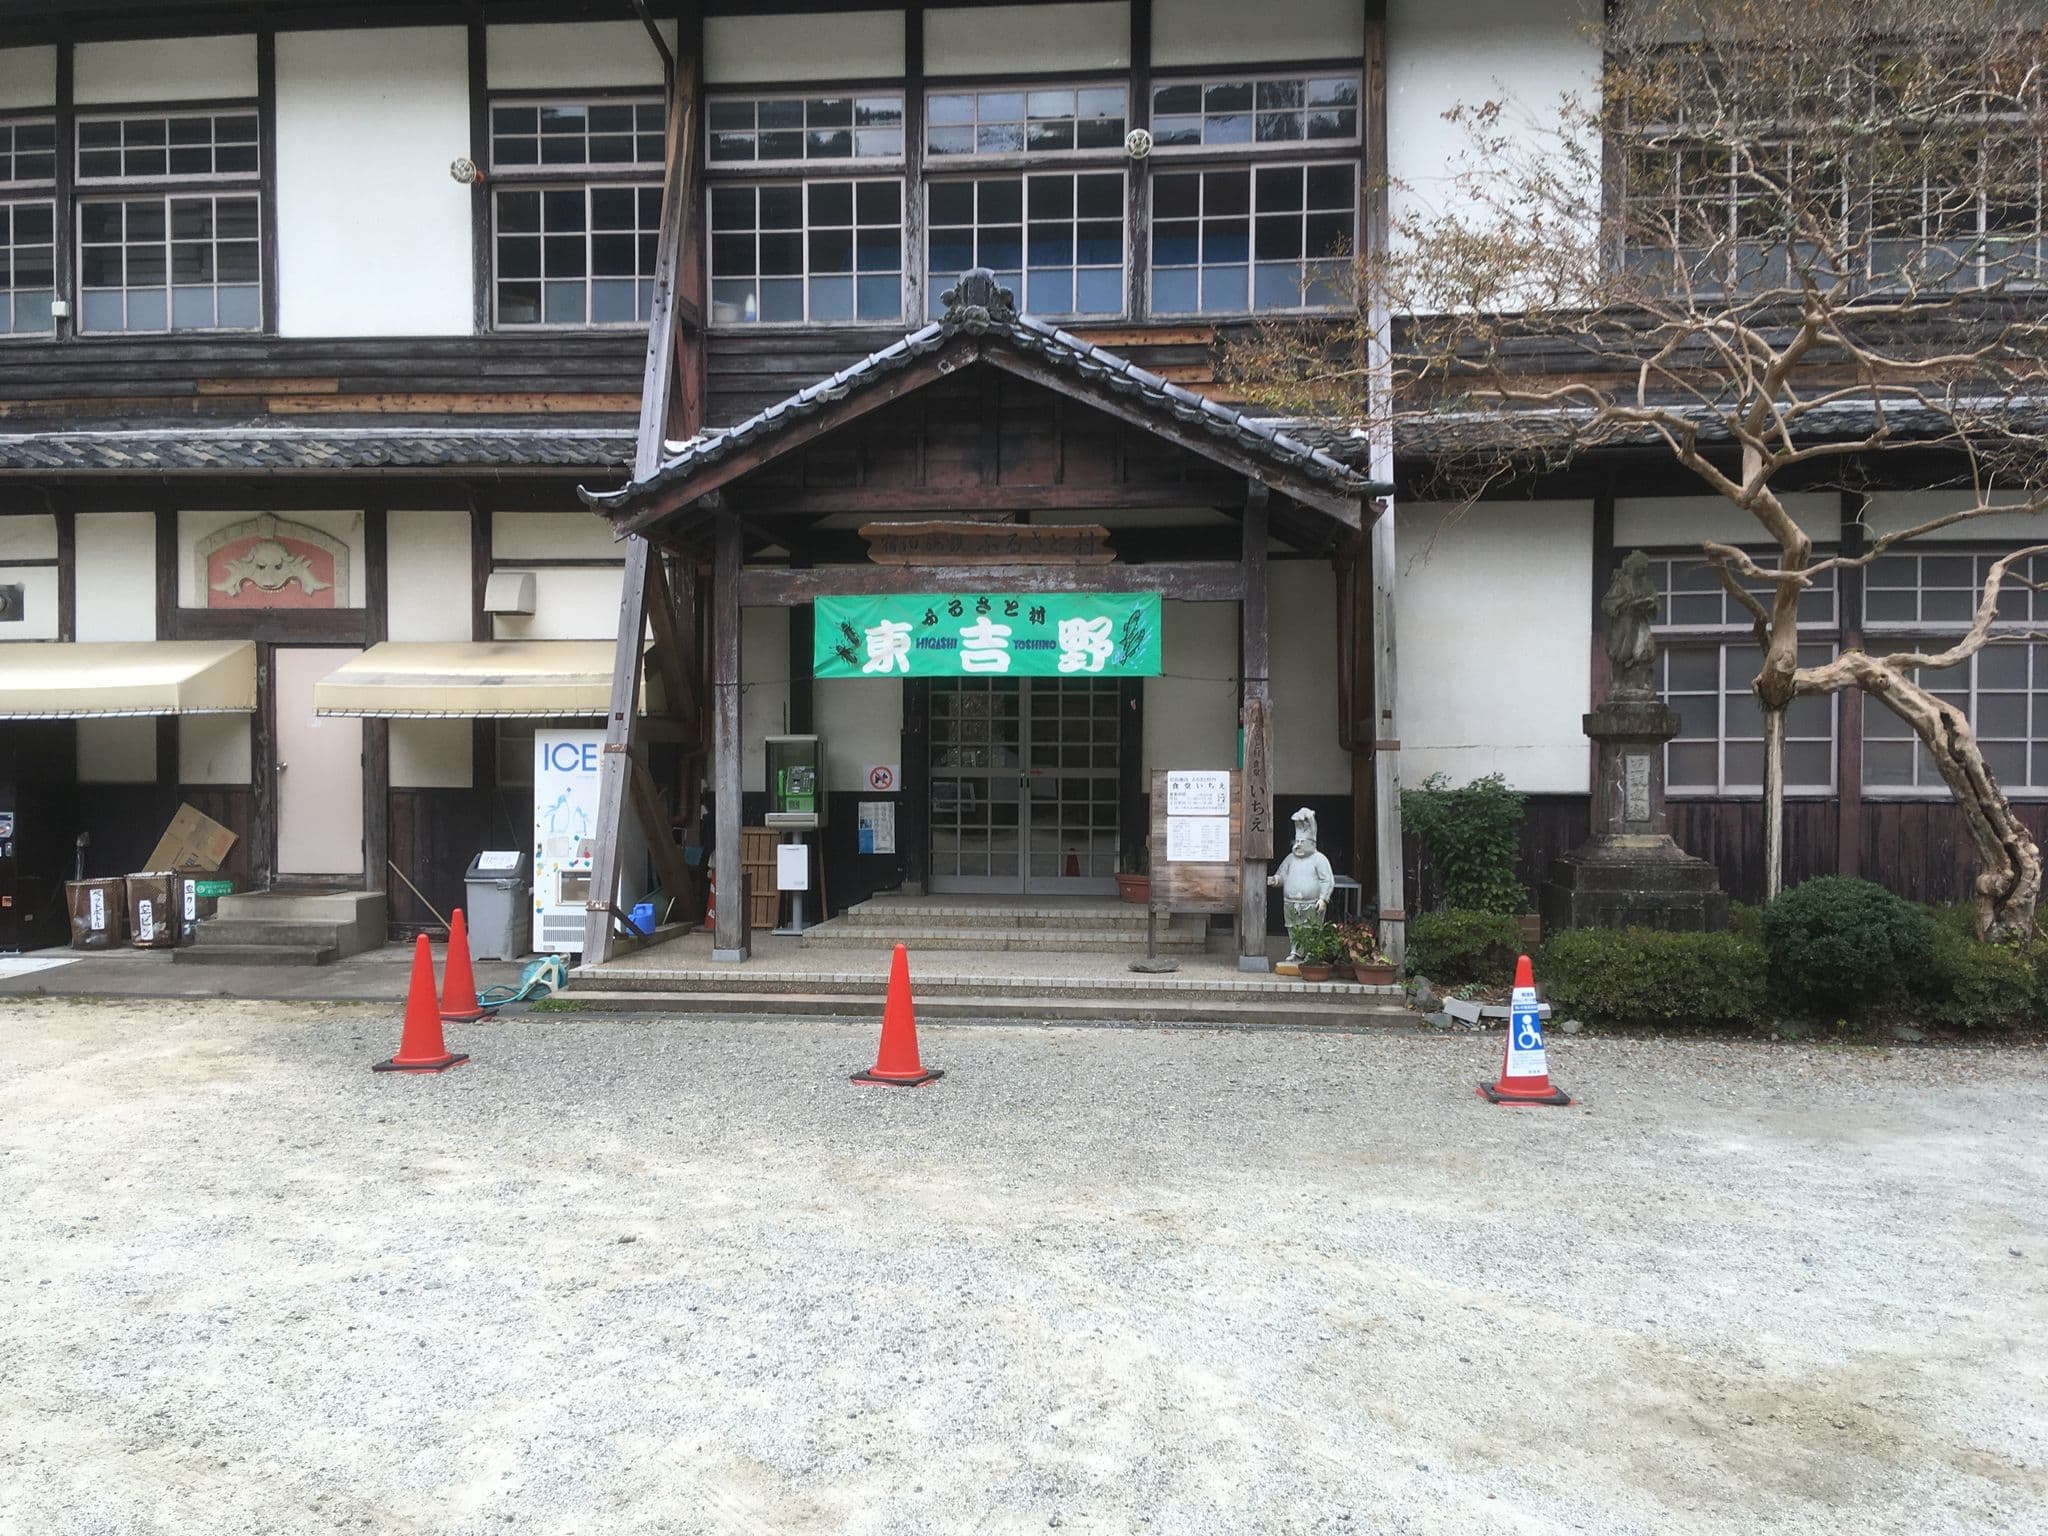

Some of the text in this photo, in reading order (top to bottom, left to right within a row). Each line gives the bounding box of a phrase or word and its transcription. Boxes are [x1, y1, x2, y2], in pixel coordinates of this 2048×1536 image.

[922, 598, 1046, 626] ふるさと村
[862, 616, 1114, 674] 東吉野
[916, 637, 1057, 651] HIGASHI YOSHINO
[544, 743, 597, 772] ICE
[1251, 784, 1266, 833] いちえ
